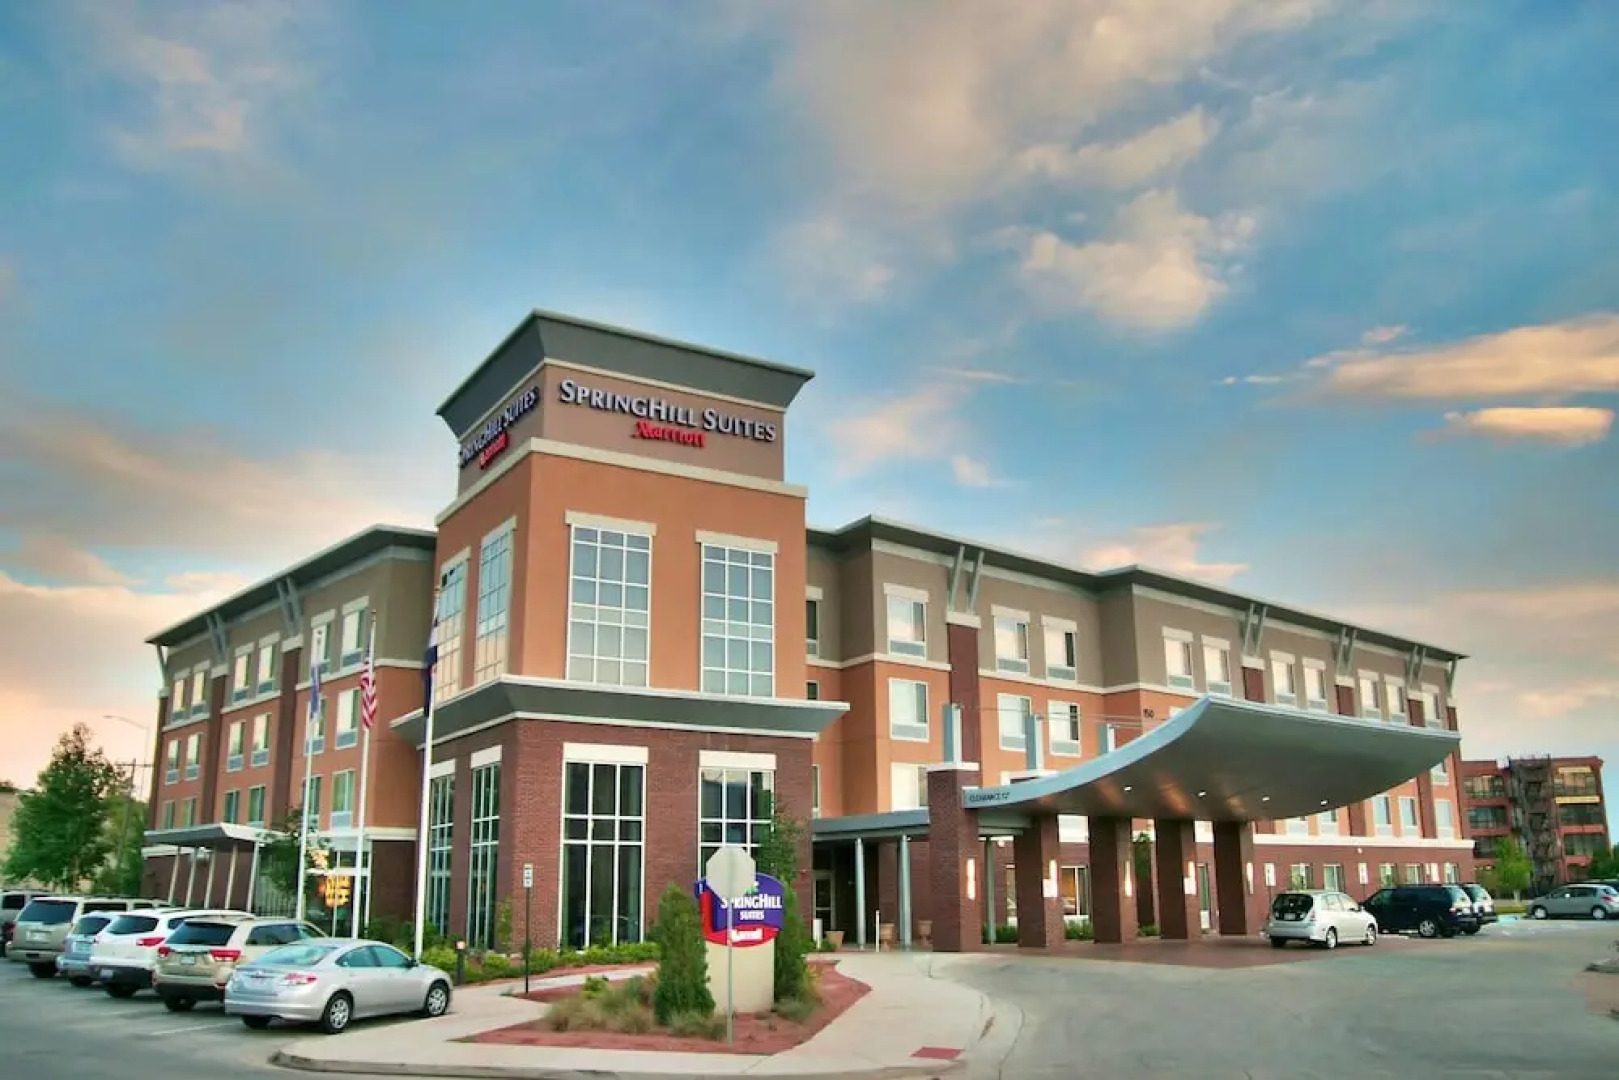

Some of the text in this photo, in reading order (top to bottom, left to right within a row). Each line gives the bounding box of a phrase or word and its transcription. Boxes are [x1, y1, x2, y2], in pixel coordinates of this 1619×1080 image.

[559, 379, 776, 442] SPRINGHILL SUITES
[632, 419, 707, 448] Marriott
